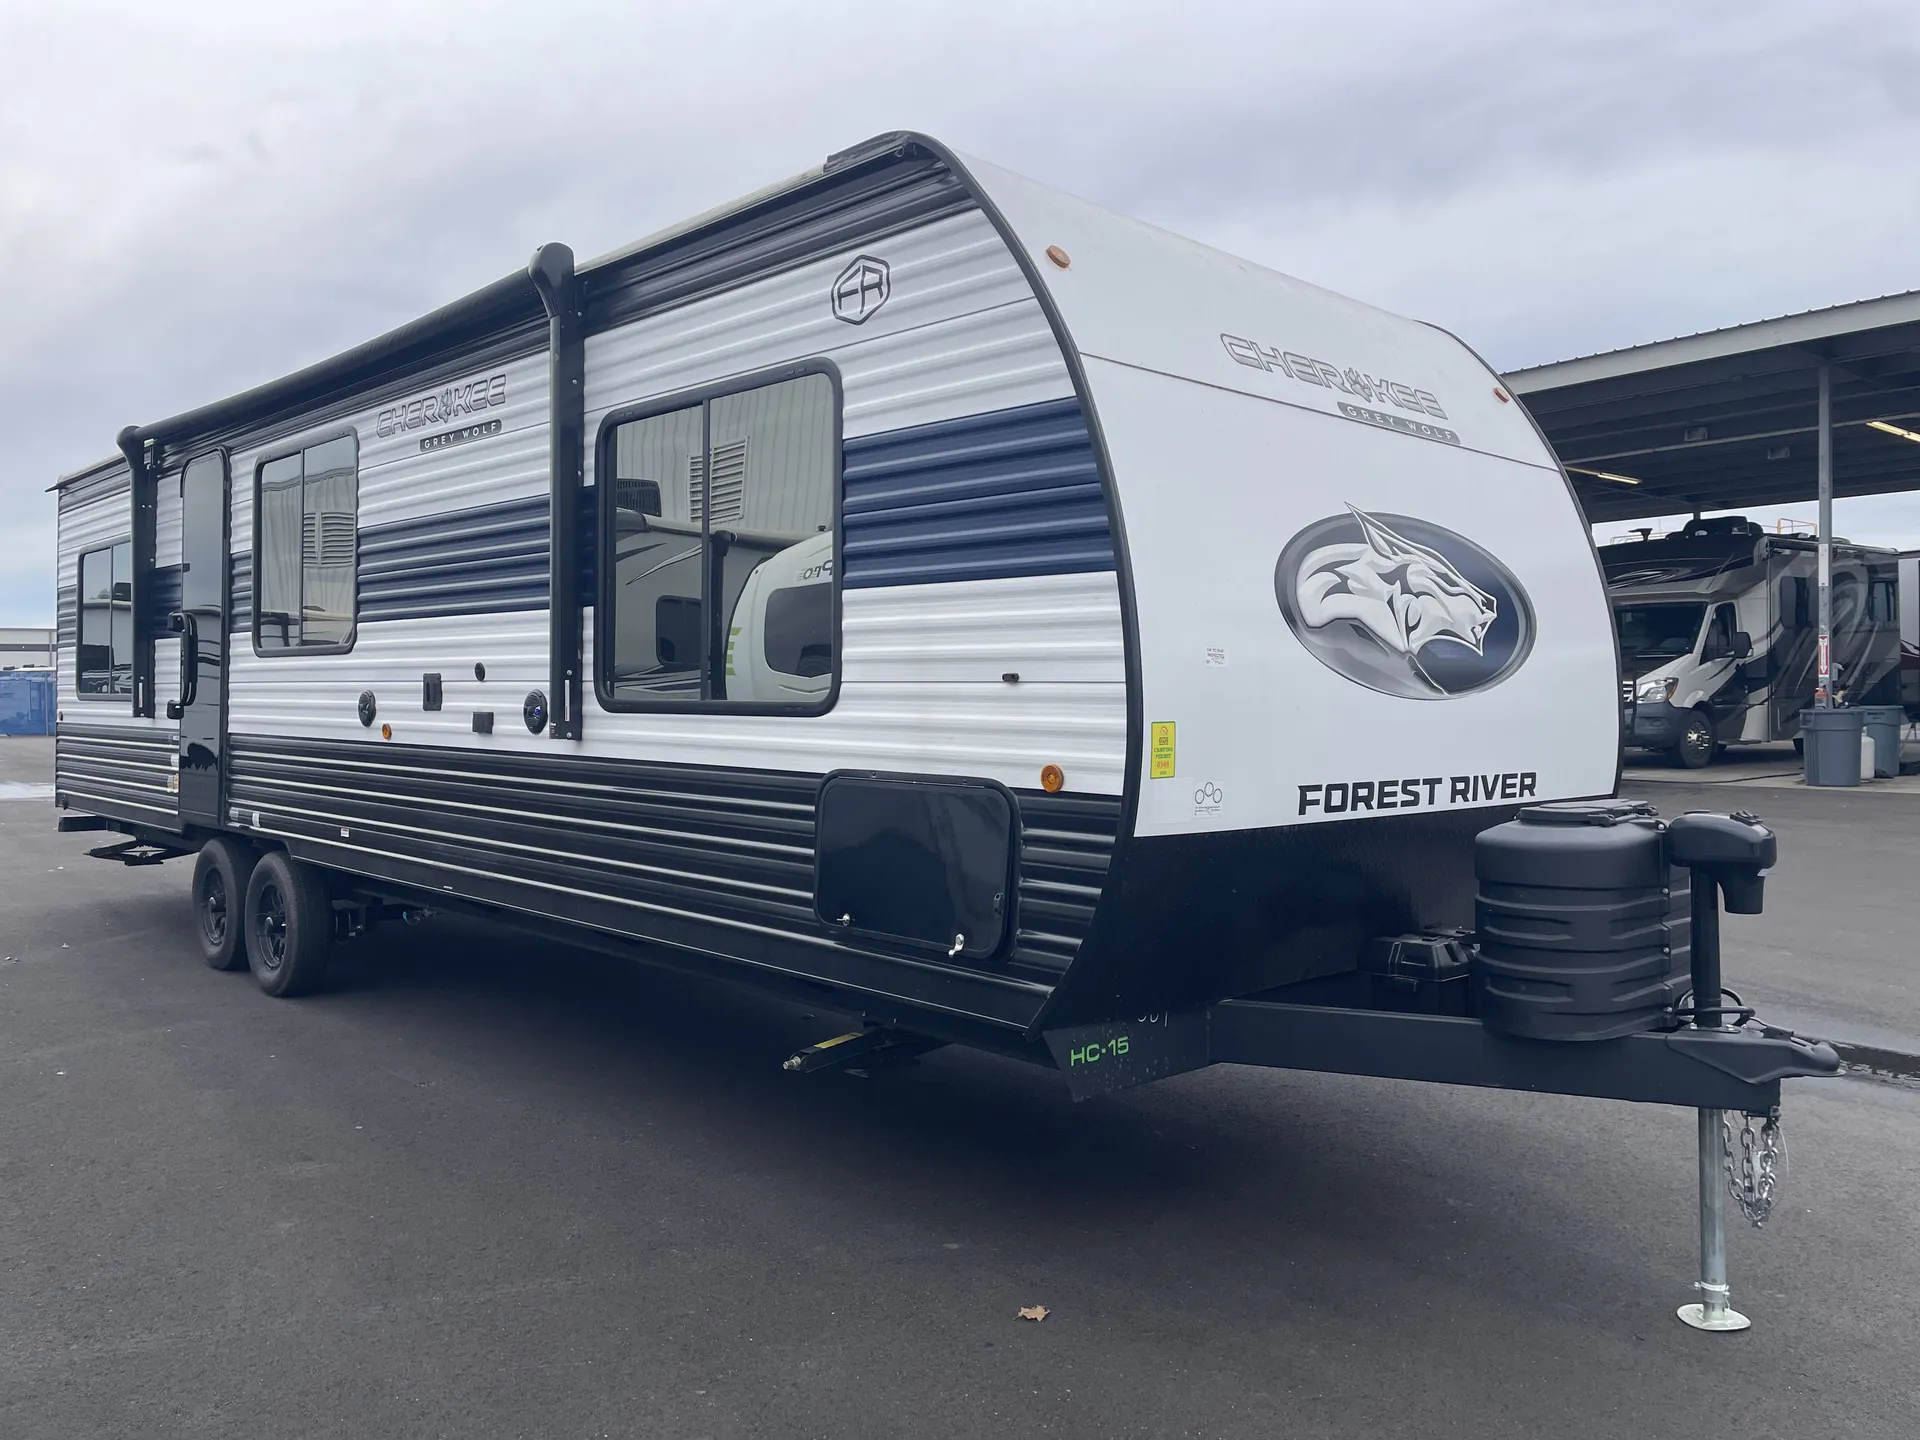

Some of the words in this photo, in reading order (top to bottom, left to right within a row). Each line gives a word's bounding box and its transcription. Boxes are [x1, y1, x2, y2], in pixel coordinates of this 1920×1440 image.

[424, 433, 455, 449] GREY
[462, 422, 497, 439] WOLF
[1347, 406, 1396, 425] GREY
[1406, 421, 1452, 441] WOLF
[1297, 777, 1443, 816] FOREST
[1449, 771, 1537, 803] RIVER
[1070, 1036, 1130, 1067] HC-15
